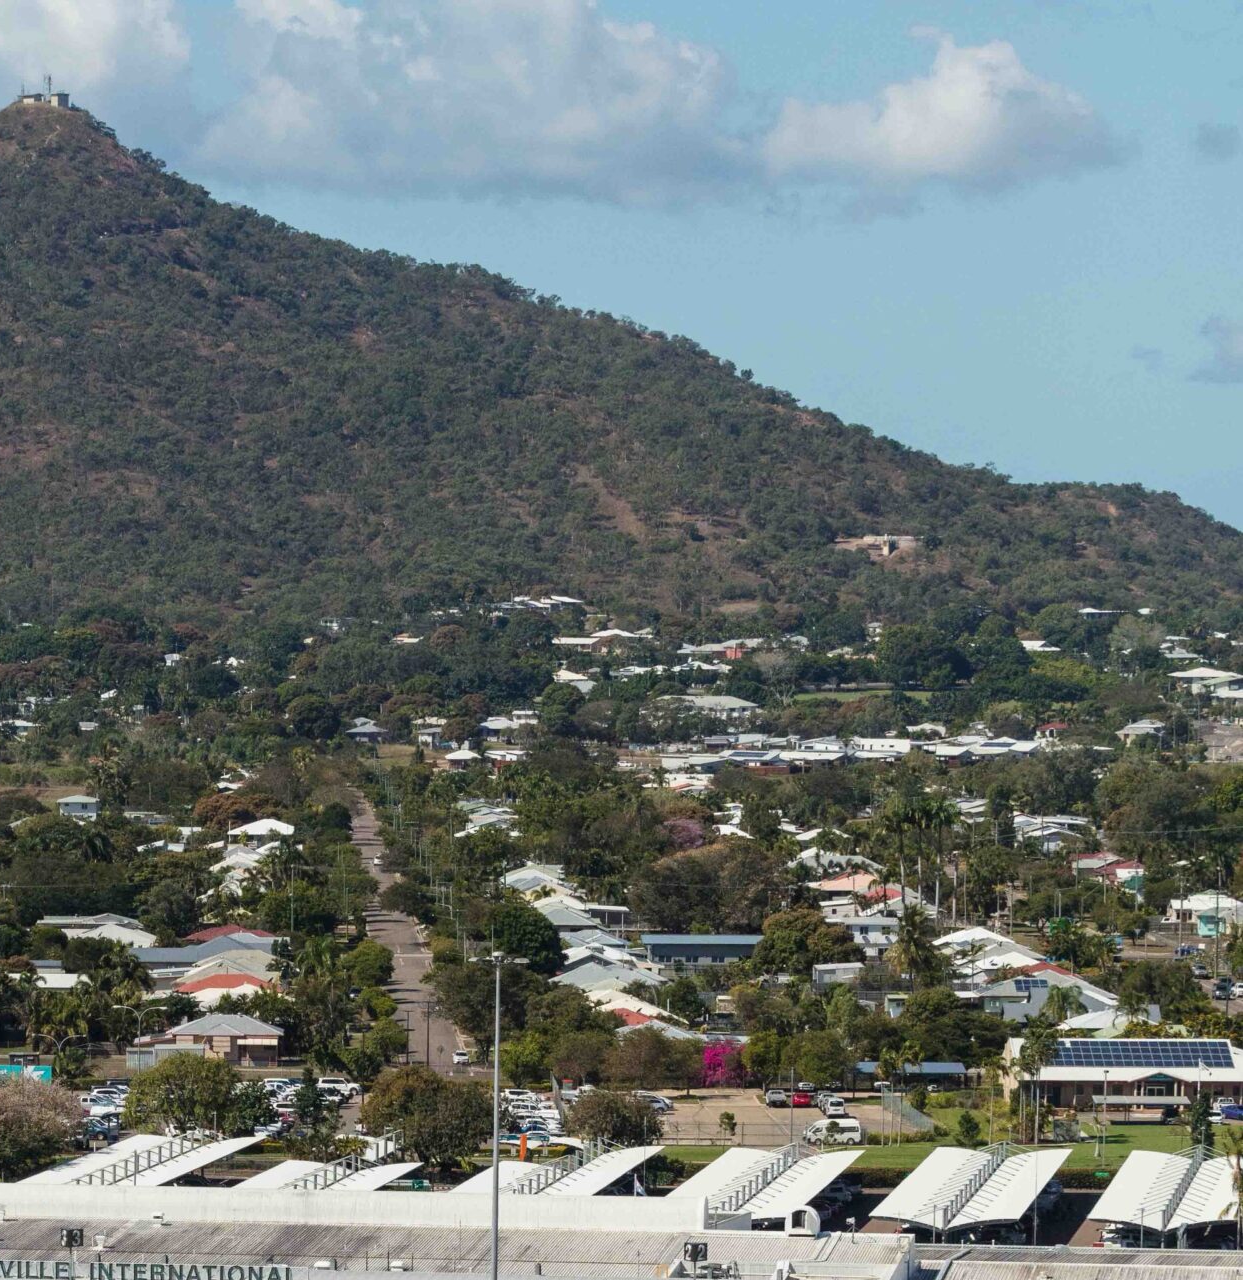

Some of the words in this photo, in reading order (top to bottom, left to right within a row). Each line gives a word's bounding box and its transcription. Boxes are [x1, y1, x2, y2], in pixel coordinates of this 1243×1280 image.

[72, 1229, 81, 1246] 3
[685, 1244, 692, 1260] 2
[697, 1244, 706, 1260] 2
